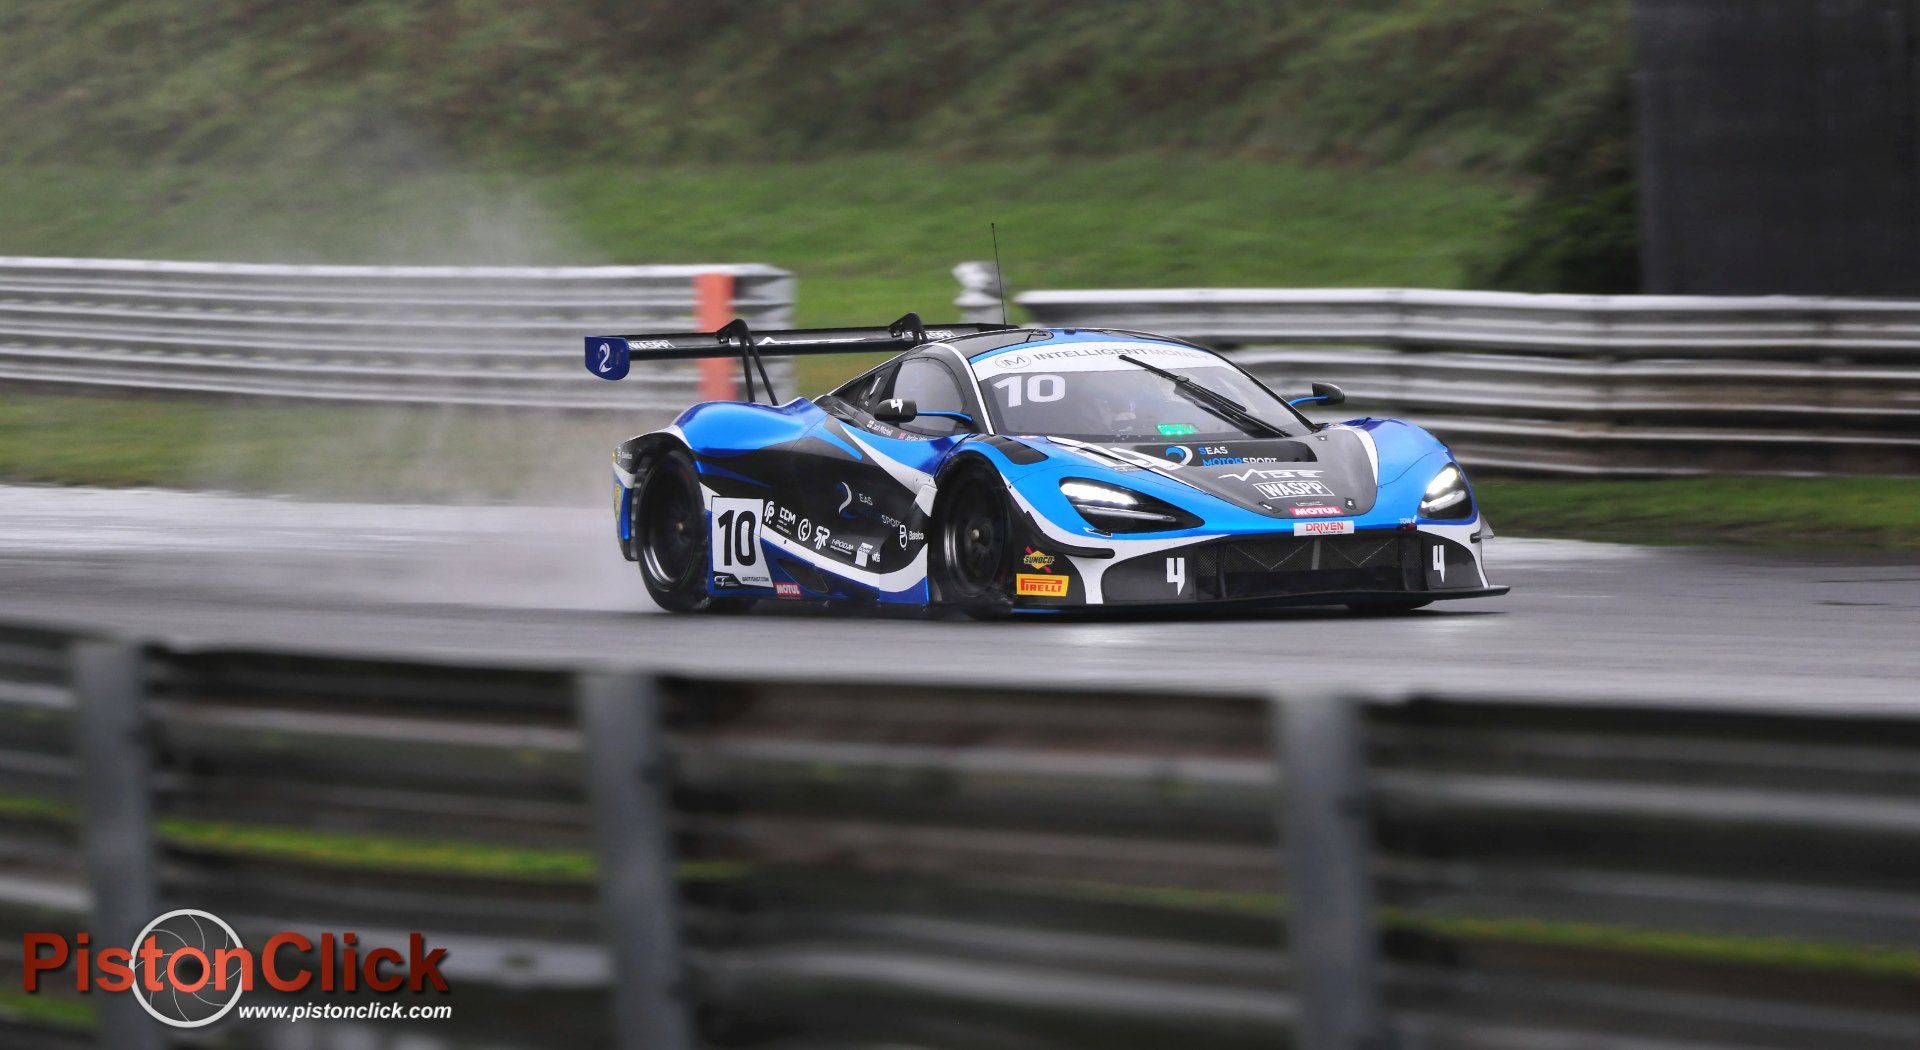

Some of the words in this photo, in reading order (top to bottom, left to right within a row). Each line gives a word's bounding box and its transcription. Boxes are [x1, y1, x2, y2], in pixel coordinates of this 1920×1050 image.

[993, 374, 1066, 408] 10
[1198, 446, 1228, 455] SEAS
[1260, 481, 1323, 497] WASPP
[1295, 506, 1340, 516] MOTUL
[1305, 522, 1344, 534] DRIVEN
[717, 510, 756, 566] 10
[1023, 555, 1055, 565] SUNOCO
[776, 584, 800, 595] MOTUL
[1020, 578, 1062, 593] PIRELLI
